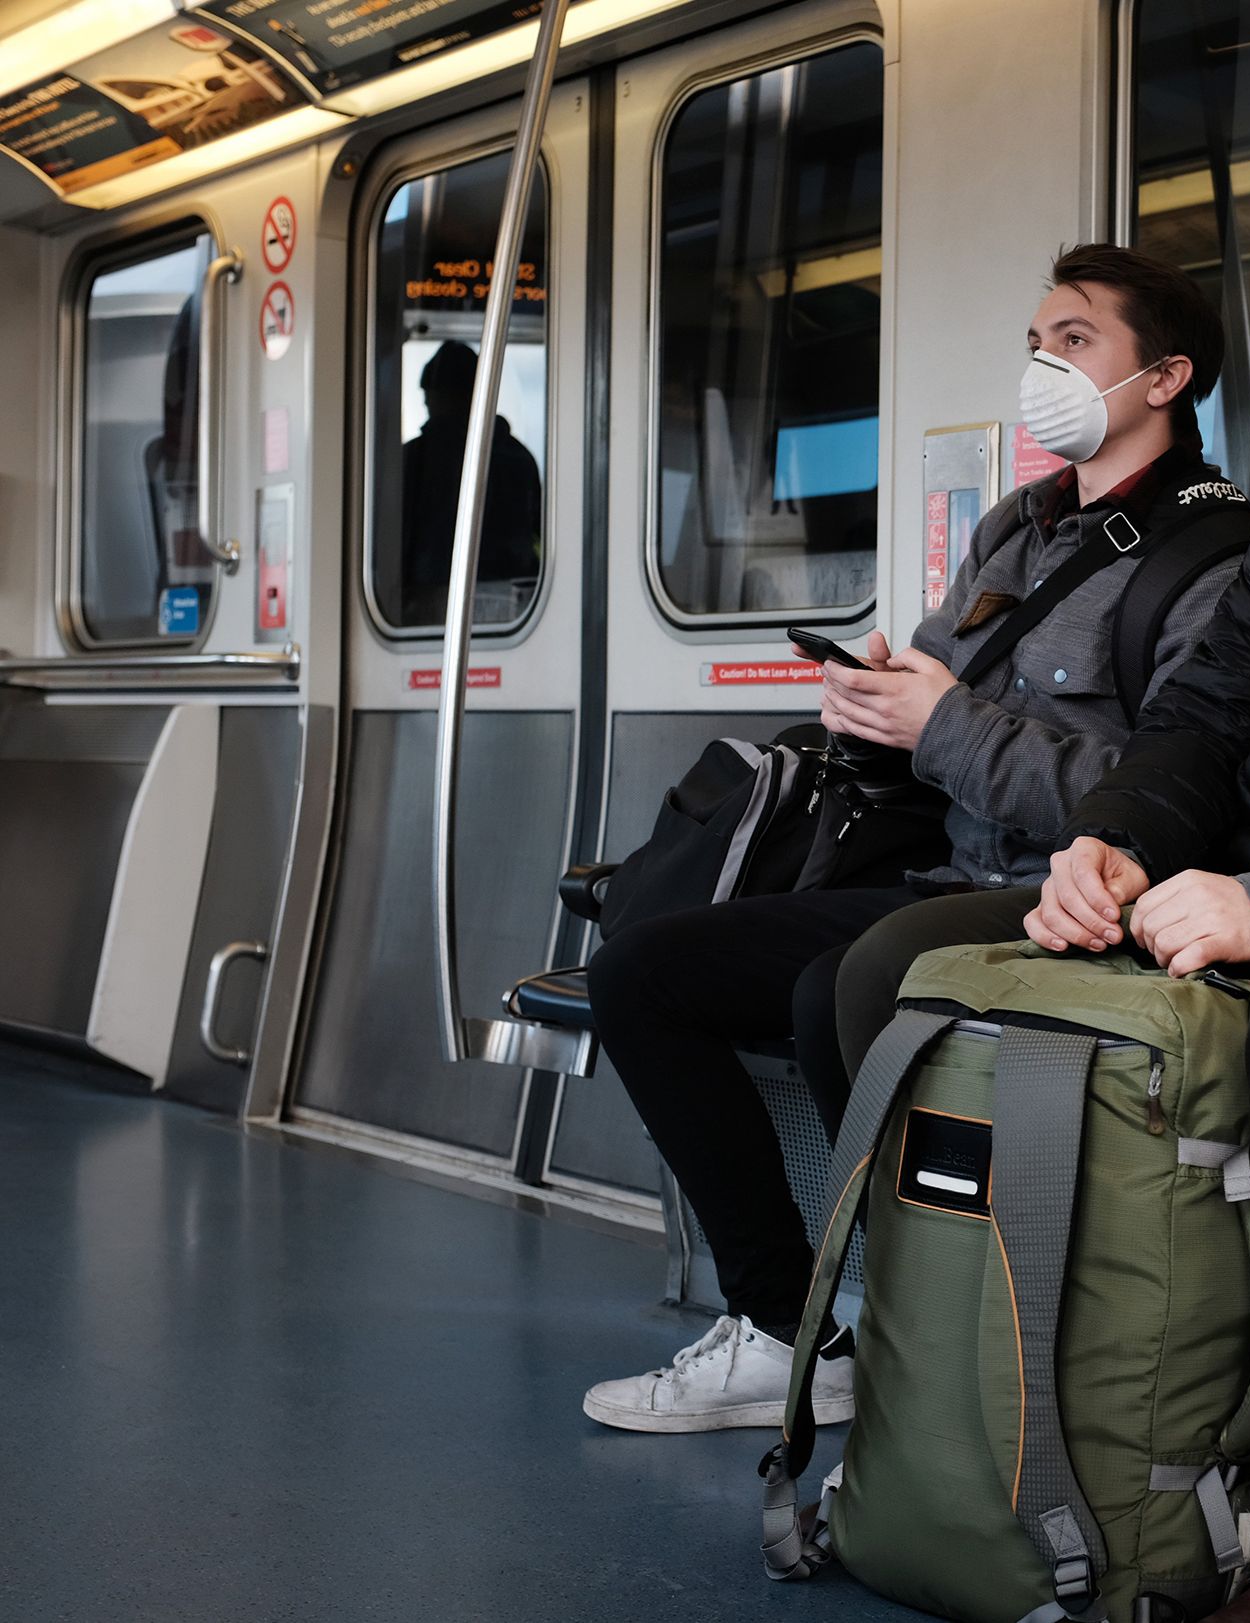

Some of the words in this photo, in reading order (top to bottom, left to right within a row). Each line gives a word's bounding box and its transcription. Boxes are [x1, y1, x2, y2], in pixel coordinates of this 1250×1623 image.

[1177, 481, 1247, 505] Titleist
[719, 668, 747, 679] Caution!
[747, 668, 758, 679] Do
[758, 667, 771, 678] Not
[771, 667, 788, 678] Lean
[788, 666, 814, 680] Against
